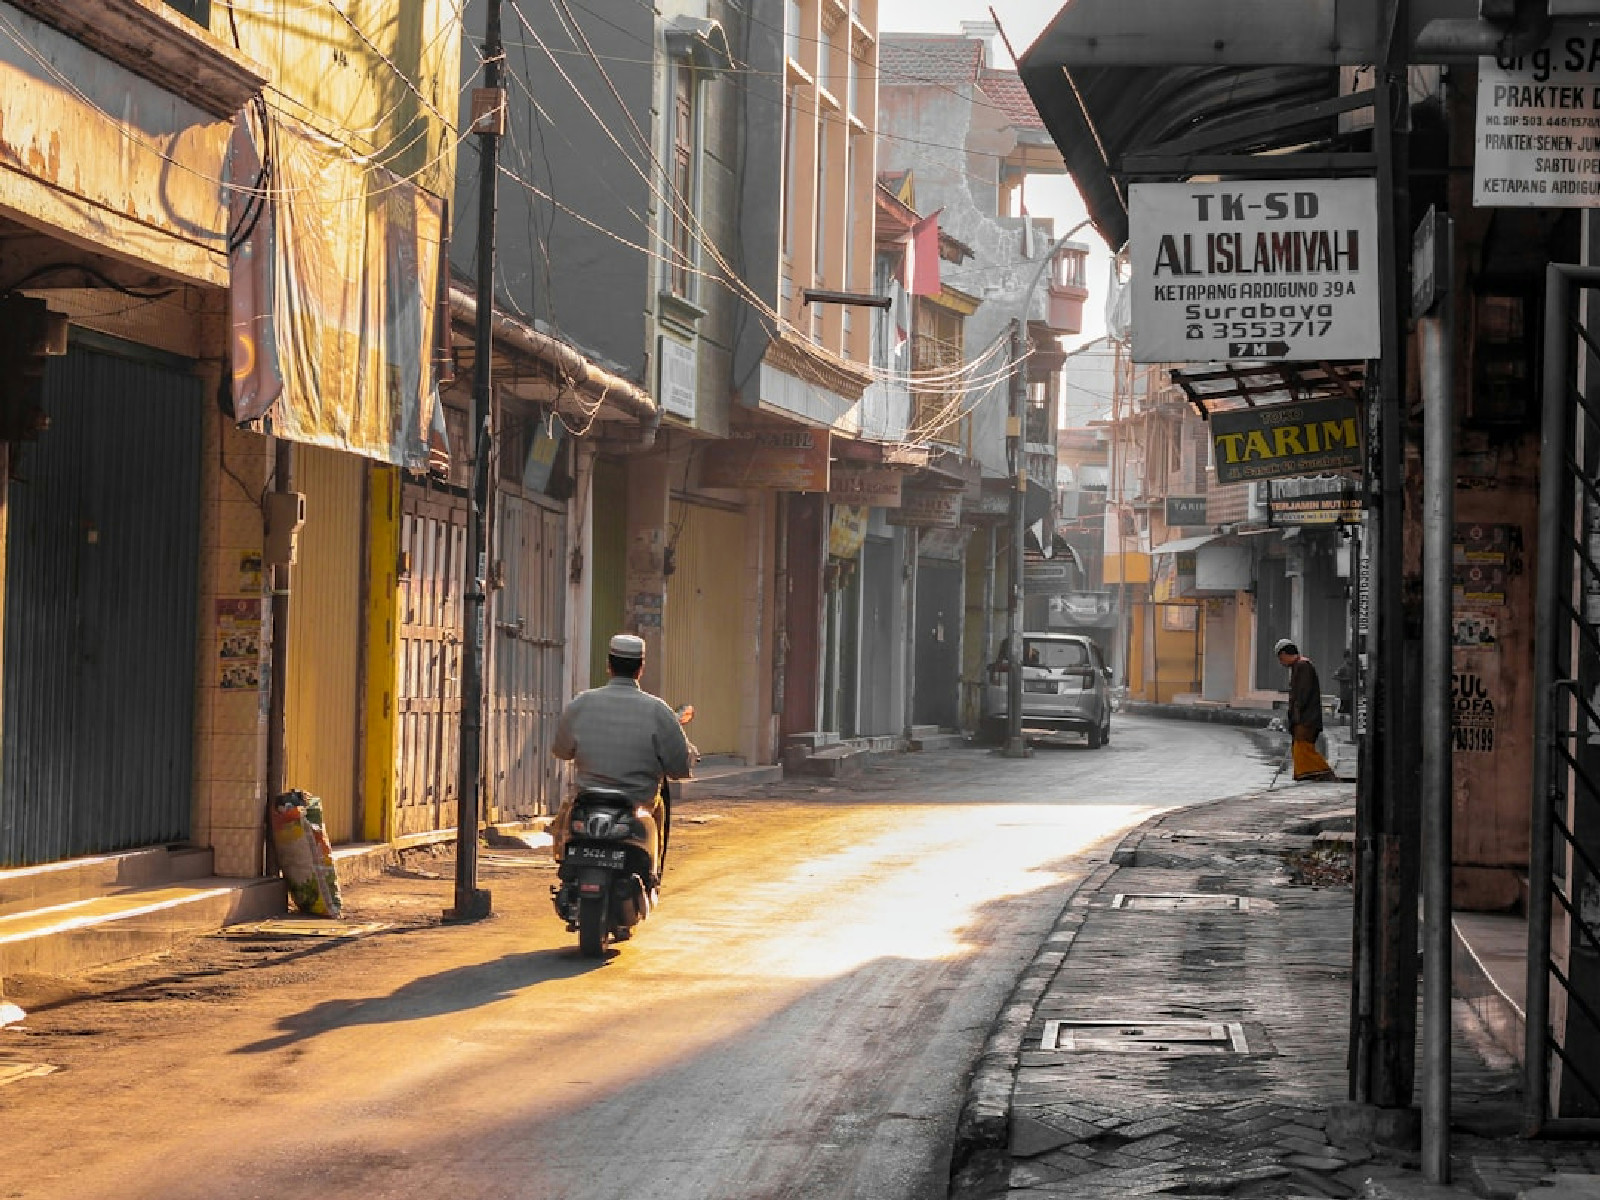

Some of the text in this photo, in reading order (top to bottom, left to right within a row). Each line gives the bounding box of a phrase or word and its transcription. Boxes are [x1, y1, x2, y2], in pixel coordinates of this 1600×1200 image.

[1493, 85, 1584, 108] PRAKTEK
[1483, 178, 1547, 194] KETAPANG
[1191, 191, 1319, 221] TK-SD
[1154, 283, 1237, 301] KETAPANG
[1240, 281, 1317, 299] ARDIGUNO
[1185, 303, 1333, 320] Surabaya
[1212, 321, 1333, 338] 3553717
[1214, 416, 1360, 464] TARIM
[1450, 699, 1495, 712] OFA
